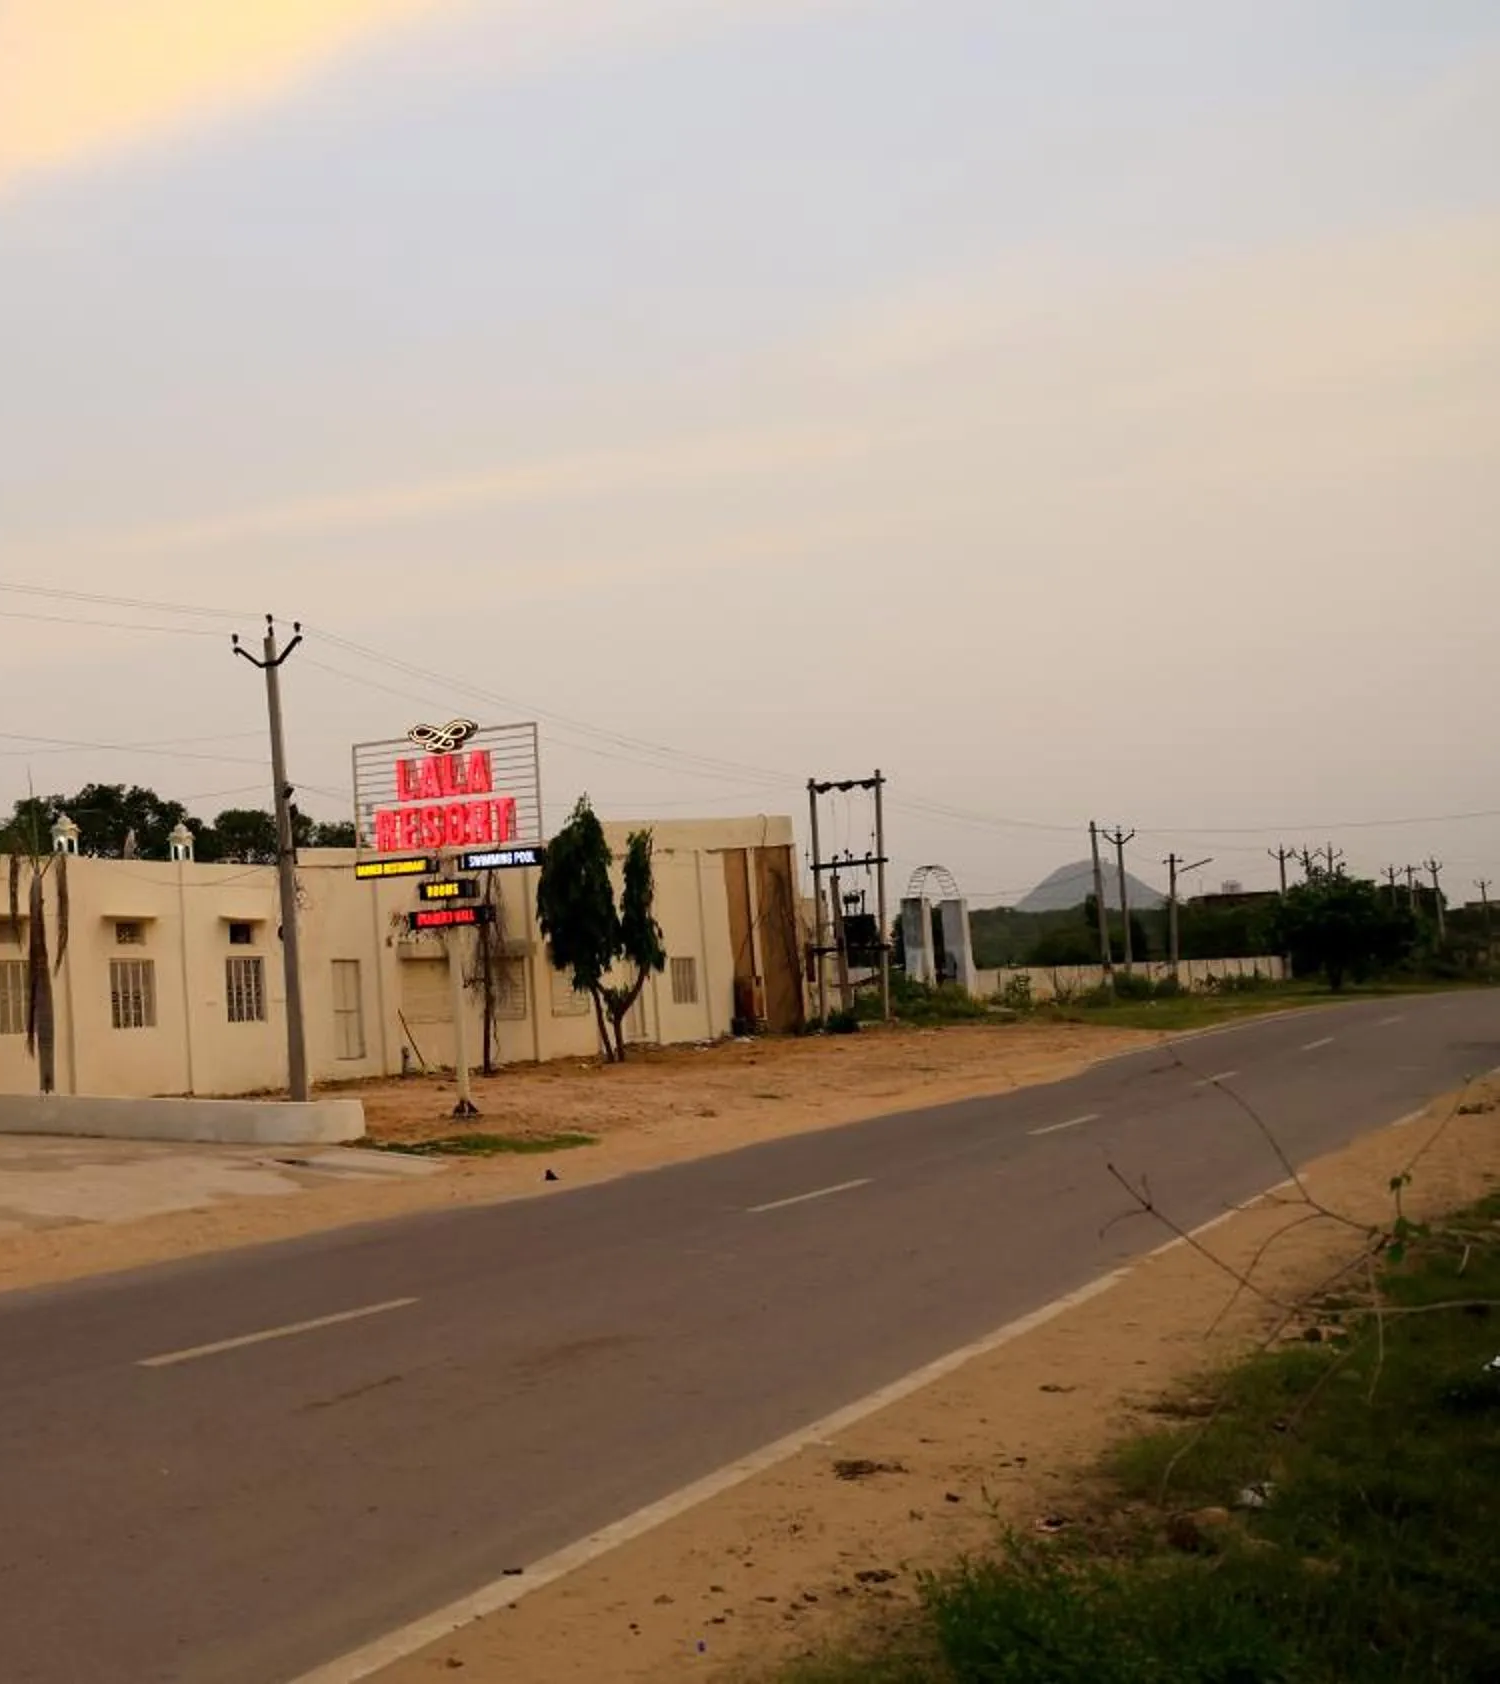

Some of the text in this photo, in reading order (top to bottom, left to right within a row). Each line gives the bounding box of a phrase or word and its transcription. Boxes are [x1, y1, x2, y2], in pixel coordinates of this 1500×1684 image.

[395, 749, 493, 801] LALA
[374, 797, 517, 852] RESORT
[513, 850, 536, 864] POOL
